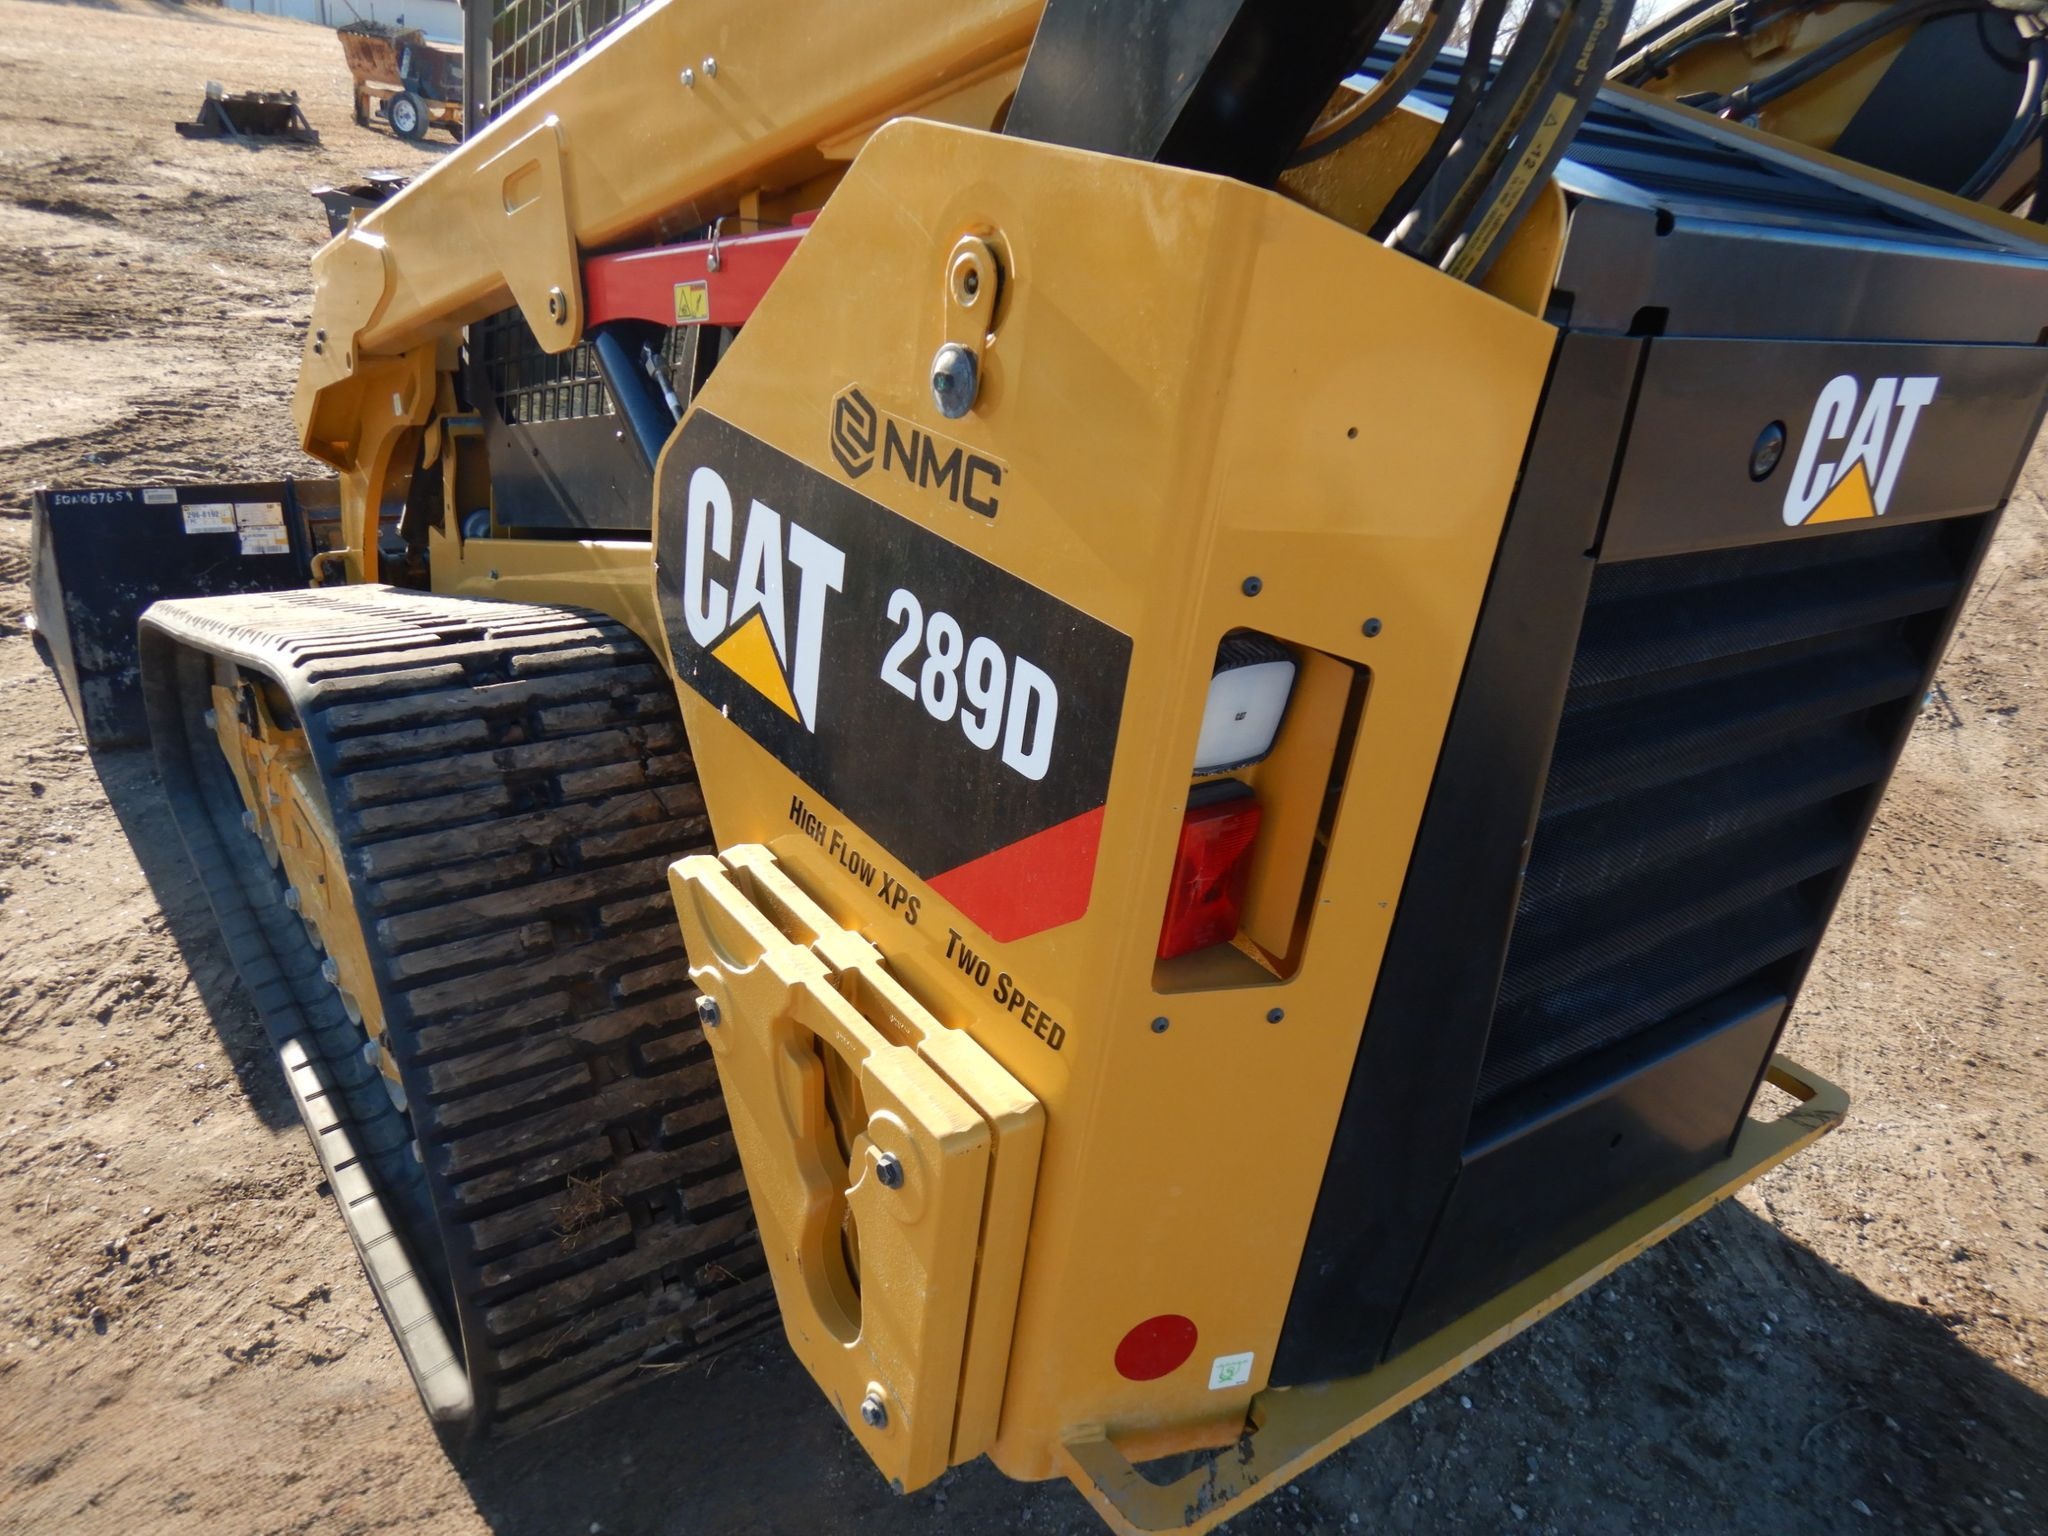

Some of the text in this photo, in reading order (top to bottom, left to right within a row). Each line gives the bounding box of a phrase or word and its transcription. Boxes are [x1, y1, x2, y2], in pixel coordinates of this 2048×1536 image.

[883, 419, 1001, 518] NMC
[1782, 375, 1939, 526] CAT
[684, 466, 1059, 782] CAT 289D
[878, 871, 922, 926] XPS
